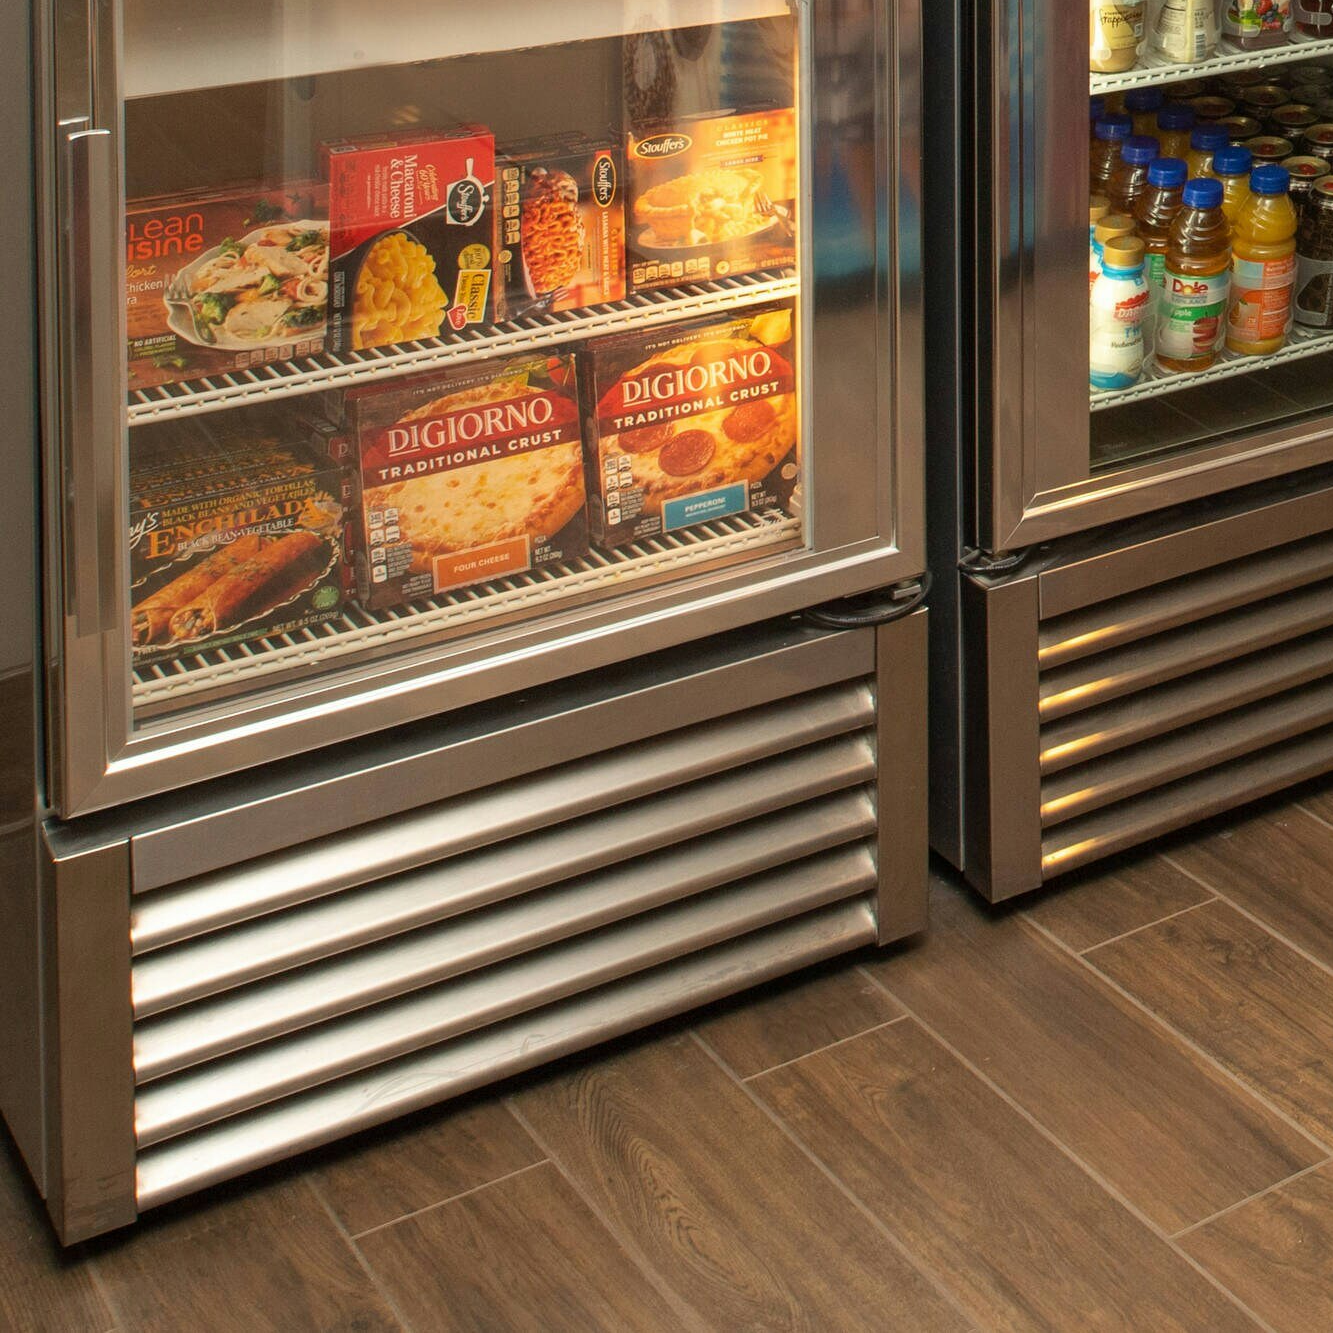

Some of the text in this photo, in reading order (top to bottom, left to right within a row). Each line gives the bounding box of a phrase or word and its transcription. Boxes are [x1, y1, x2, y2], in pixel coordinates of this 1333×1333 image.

[640, 138, 685, 155] Stouffer's
[390, 170, 403, 218] Cheese
[404, 154, 418, 218] Macaroni
[598, 161, 612, 202] Stouffer's
[129, 212, 204, 242] Lean
[468, 273, 486, 319] Classic
[1172, 279, 1209, 295] Dole
[614, 380, 779, 430] TRADITIONAL CRUST
[378, 429, 562, 481] TRADITIONAL CRUST
[162, 479, 316, 517] MADE WITH ORGANIC TORTILLAS
[684, 496, 726, 513] PEPPERONI
[145, 496, 321, 560] ENCHILADA
[454, 553, 510, 573] FOUR CHEESE
